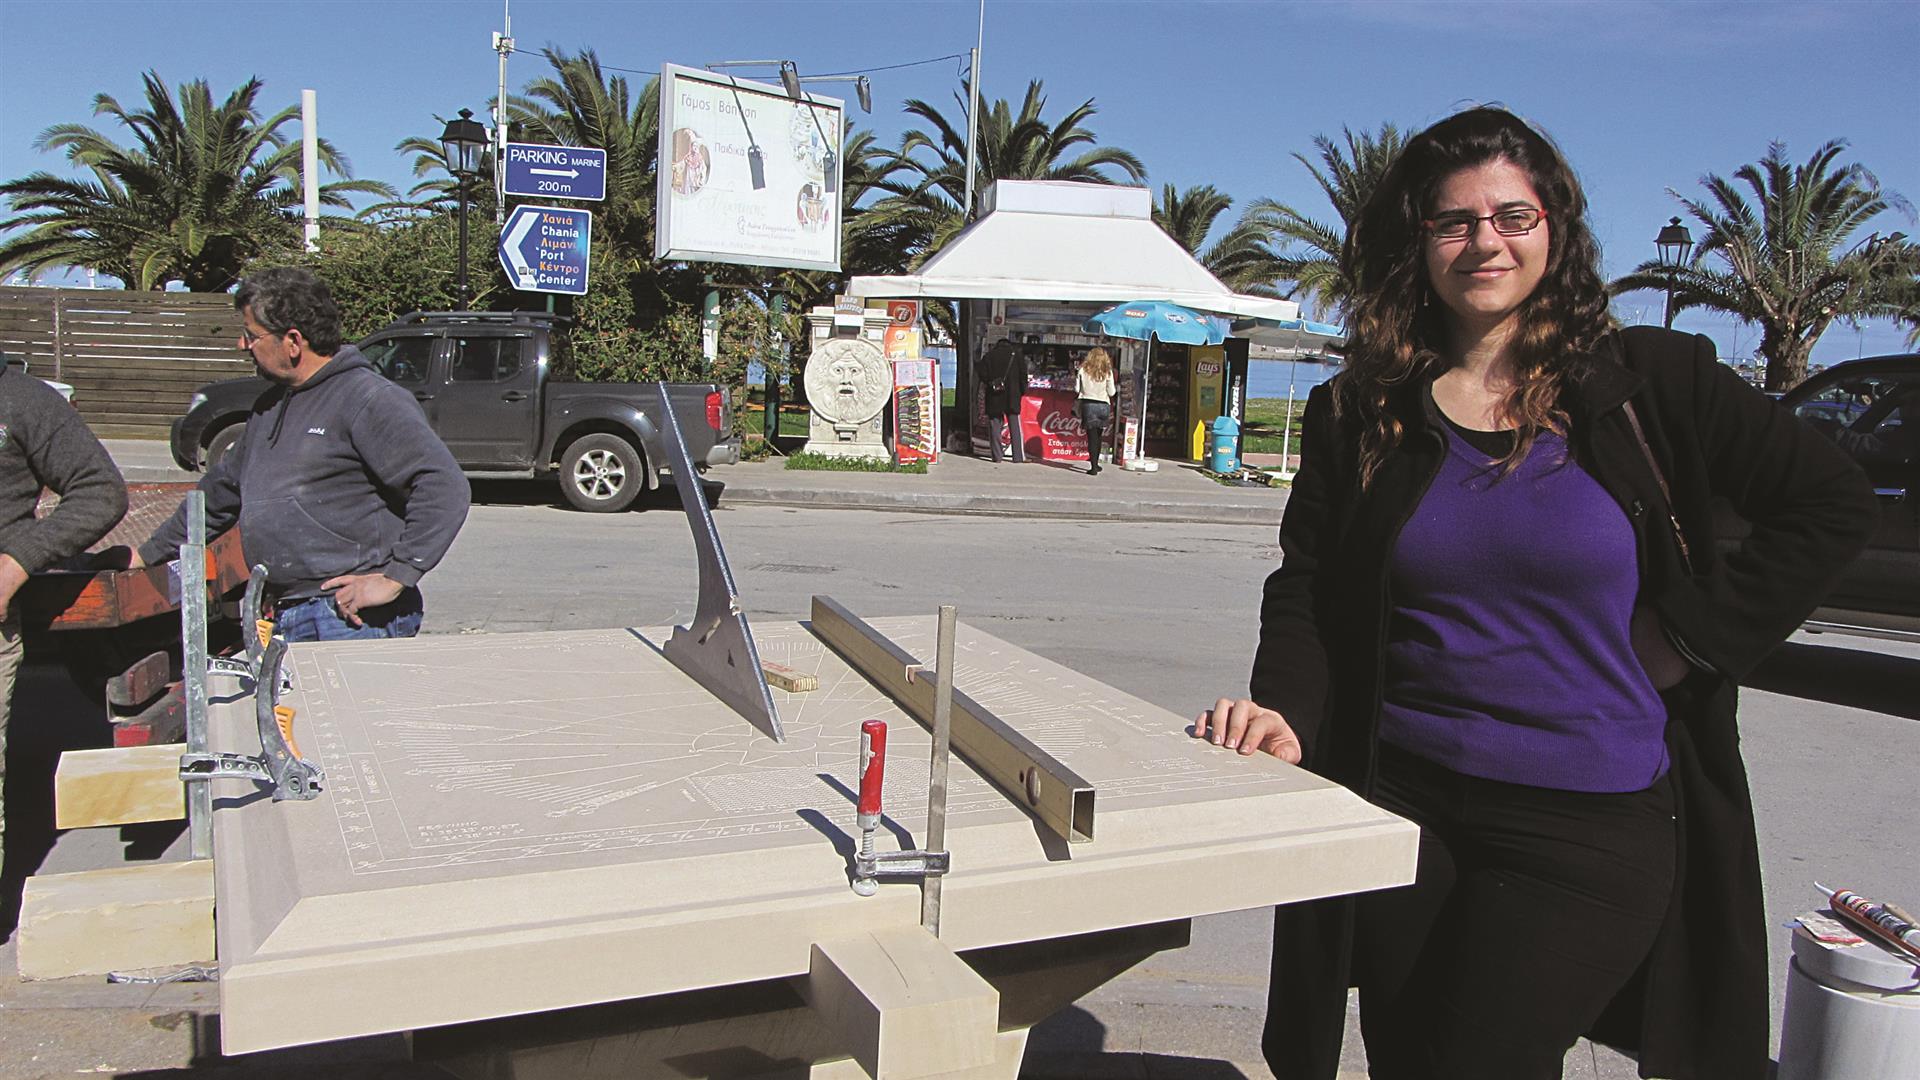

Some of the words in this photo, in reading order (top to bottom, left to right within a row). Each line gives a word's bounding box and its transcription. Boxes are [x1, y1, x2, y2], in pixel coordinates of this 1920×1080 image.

[681, 93, 711, 111] Γάμος
[510, 149, 567, 165] PARKING
[571, 158, 601, 168] MARINE
[543, 213, 573, 225] Χανιά
[541, 225, 579, 238] Chania
[541, 238, 577, 250] Λιμάνι
[540, 249, 564, 261] Port
[540, 261, 580, 275] Κέντρο
[539, 273, 577, 286] Center
